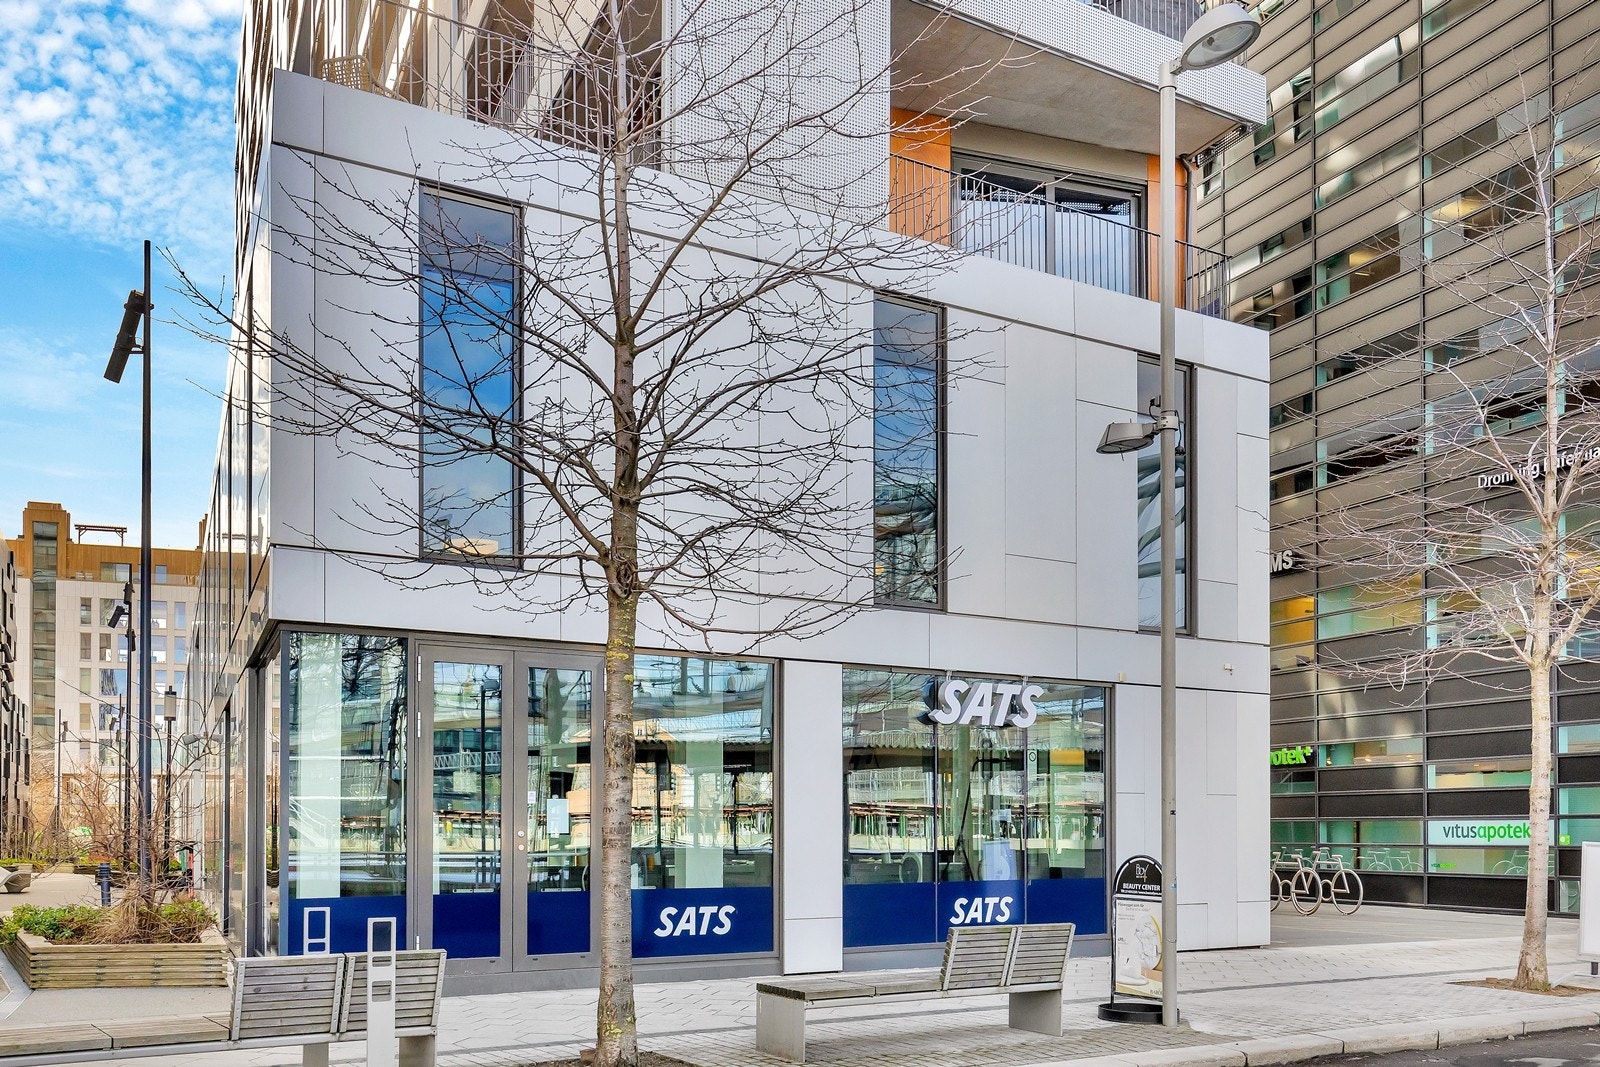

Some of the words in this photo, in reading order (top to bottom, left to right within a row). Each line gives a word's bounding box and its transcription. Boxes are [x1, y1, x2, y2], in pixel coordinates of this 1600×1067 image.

[930, 680, 1045, 728] SATS
[1443, 822, 1531, 842] vitusapotek
[653, 905, 736, 937] SATS
[949, 896, 1014, 924] SATS
